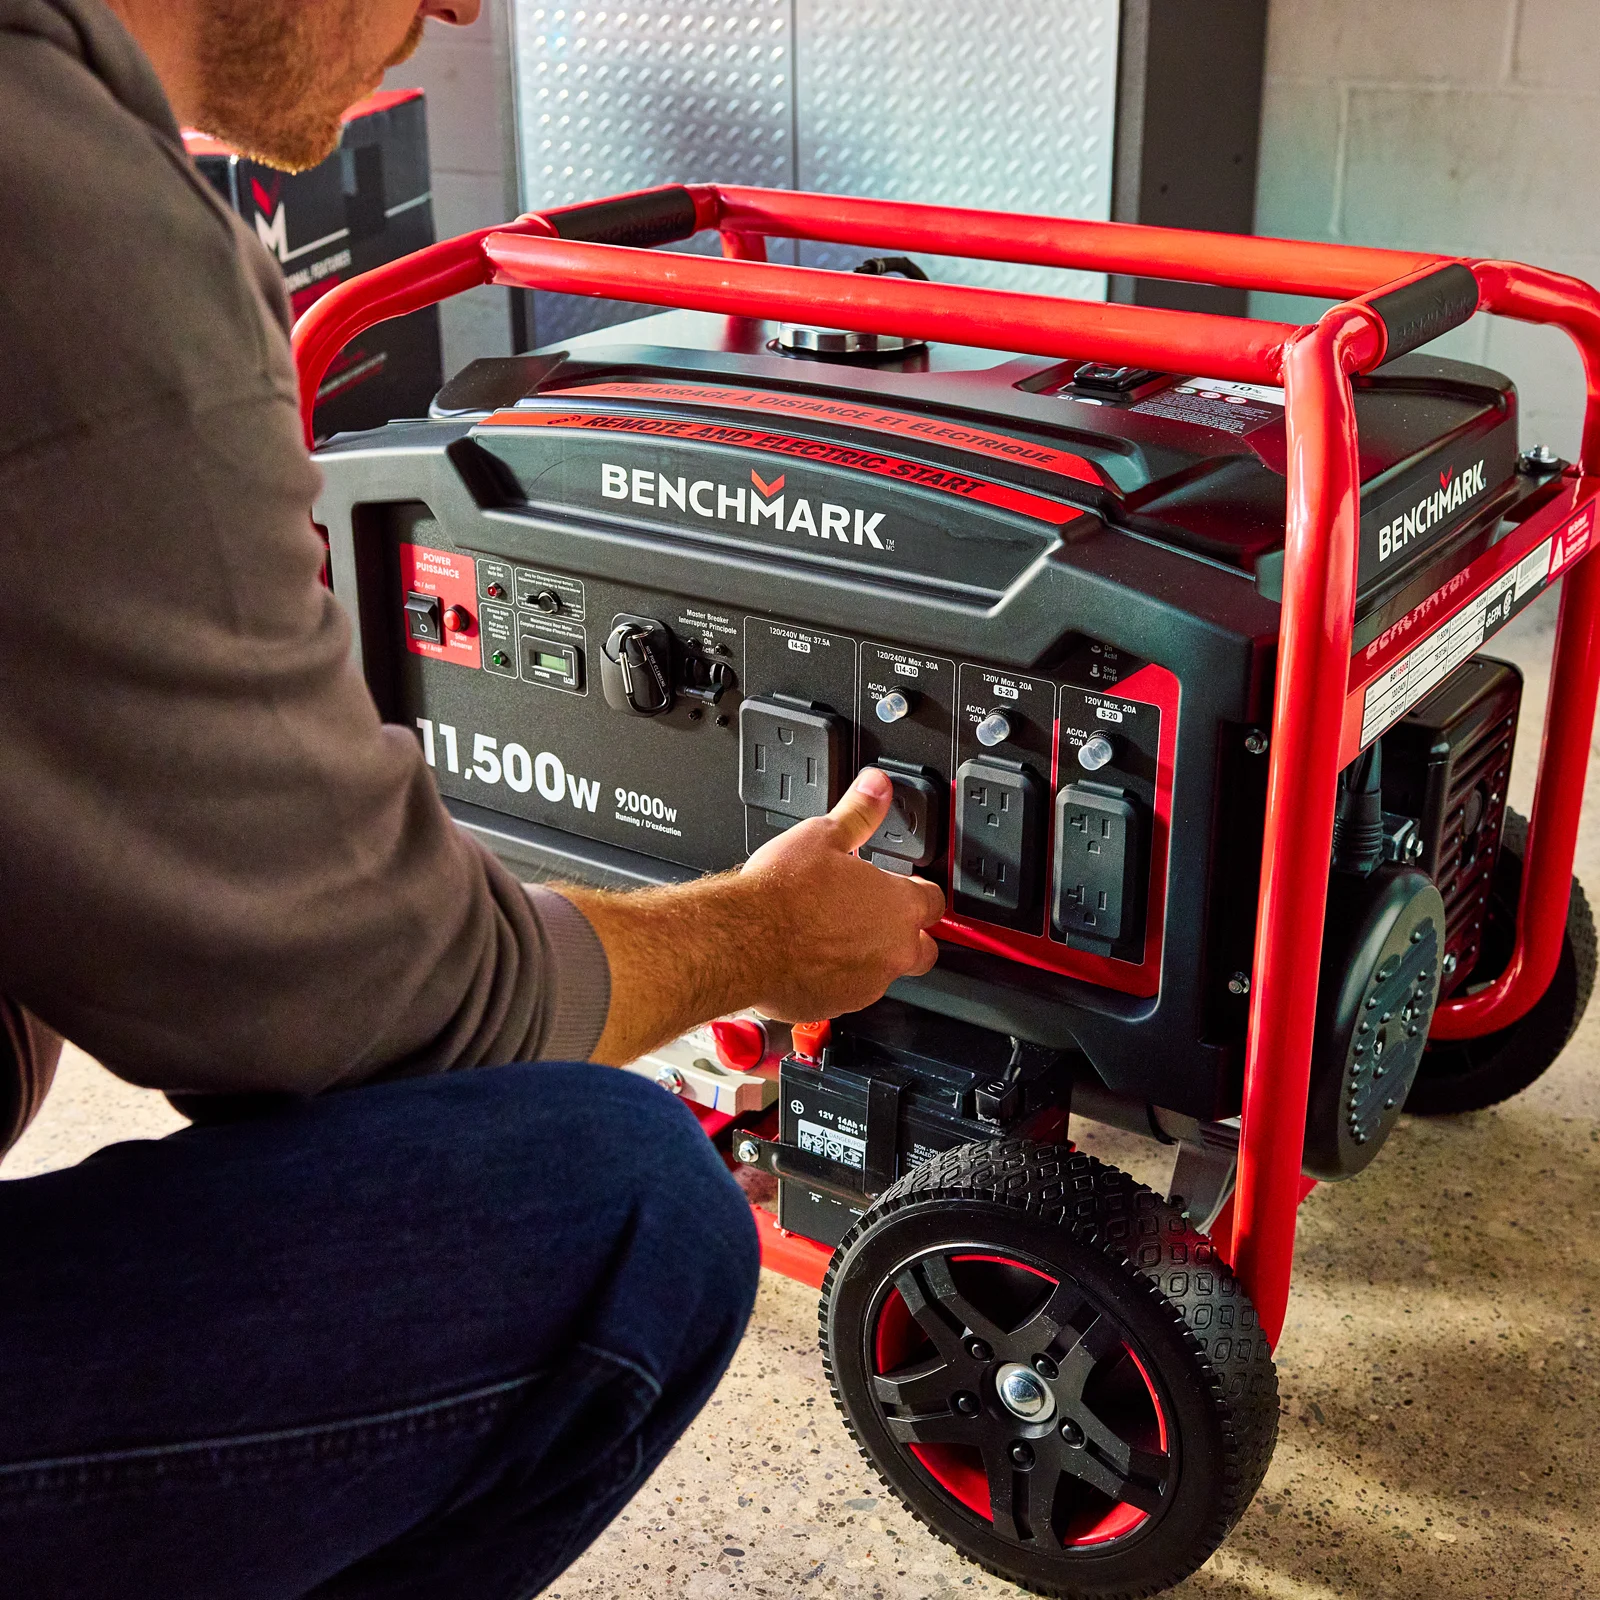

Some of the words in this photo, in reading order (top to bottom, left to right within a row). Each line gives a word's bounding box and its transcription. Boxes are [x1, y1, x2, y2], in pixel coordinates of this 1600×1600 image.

[602, 384, 733, 401] DÉMARRAGE
[743, 391, 757, 402] À
[757, 394, 869, 419] DISTANCE
[874, 415, 909, 427] ET
[915, 422, 1060, 464] ÉLECTRIQUE
[581, 416, 692, 436] REMOTE
[691, 427, 750, 443] AND
[754, 435, 889, 470] ELECTRIC
[889, 461, 987, 494] START
[601, 462, 886, 550] BENCHMARK
[1378, 459, 1485, 563] BENCHMARK
[423, 552, 451, 566] POWER
[416, 561, 460, 579] PUISSANCE
[686, 609, 706, 620] Master
[707, 613, 729, 624] Breaker
[701, 629, 714, 639] 38A
[709, 622, 737, 635] Principale
[703, 637, 712, 646] On
[769, 626, 798, 640] 120/240V
[813, 636, 831, 647] 37.5A
[790, 641, 808, 652] 14-50
[1104, 644, 1113, 652] On
[876, 650, 907, 664] 120/240V
[908, 657, 924, 668] Max.
[925, 661, 939, 671] 30A
[1103, 665, 1117, 675] Stop
[867, 682, 887, 693] AC/CA
[982, 673, 998, 684] 120V
[1000, 677, 1016, 688] Max.
[1018, 681, 1033, 691] 20A
[870, 691, 883, 701] 30A
[997, 687, 1014, 698] 5-20
[966, 704, 986, 715] AC/CA
[1084, 695, 1102, 707] 120V
[1103, 700, 1120, 711] Max.
[1122, 704, 1137, 715] 20A
[969, 713, 983, 724] 20A
[1101, 710, 1118, 721] 5-20
[1066, 727, 1087, 738] AC/CA
[1069, 737, 1083, 747] 20A
[615, 811, 641, 827] Running
[645, 819, 682, 837] D'exécution
[817, 1109, 834, 1121] 12V
[837, 1116, 858, 1129] 14Ah
